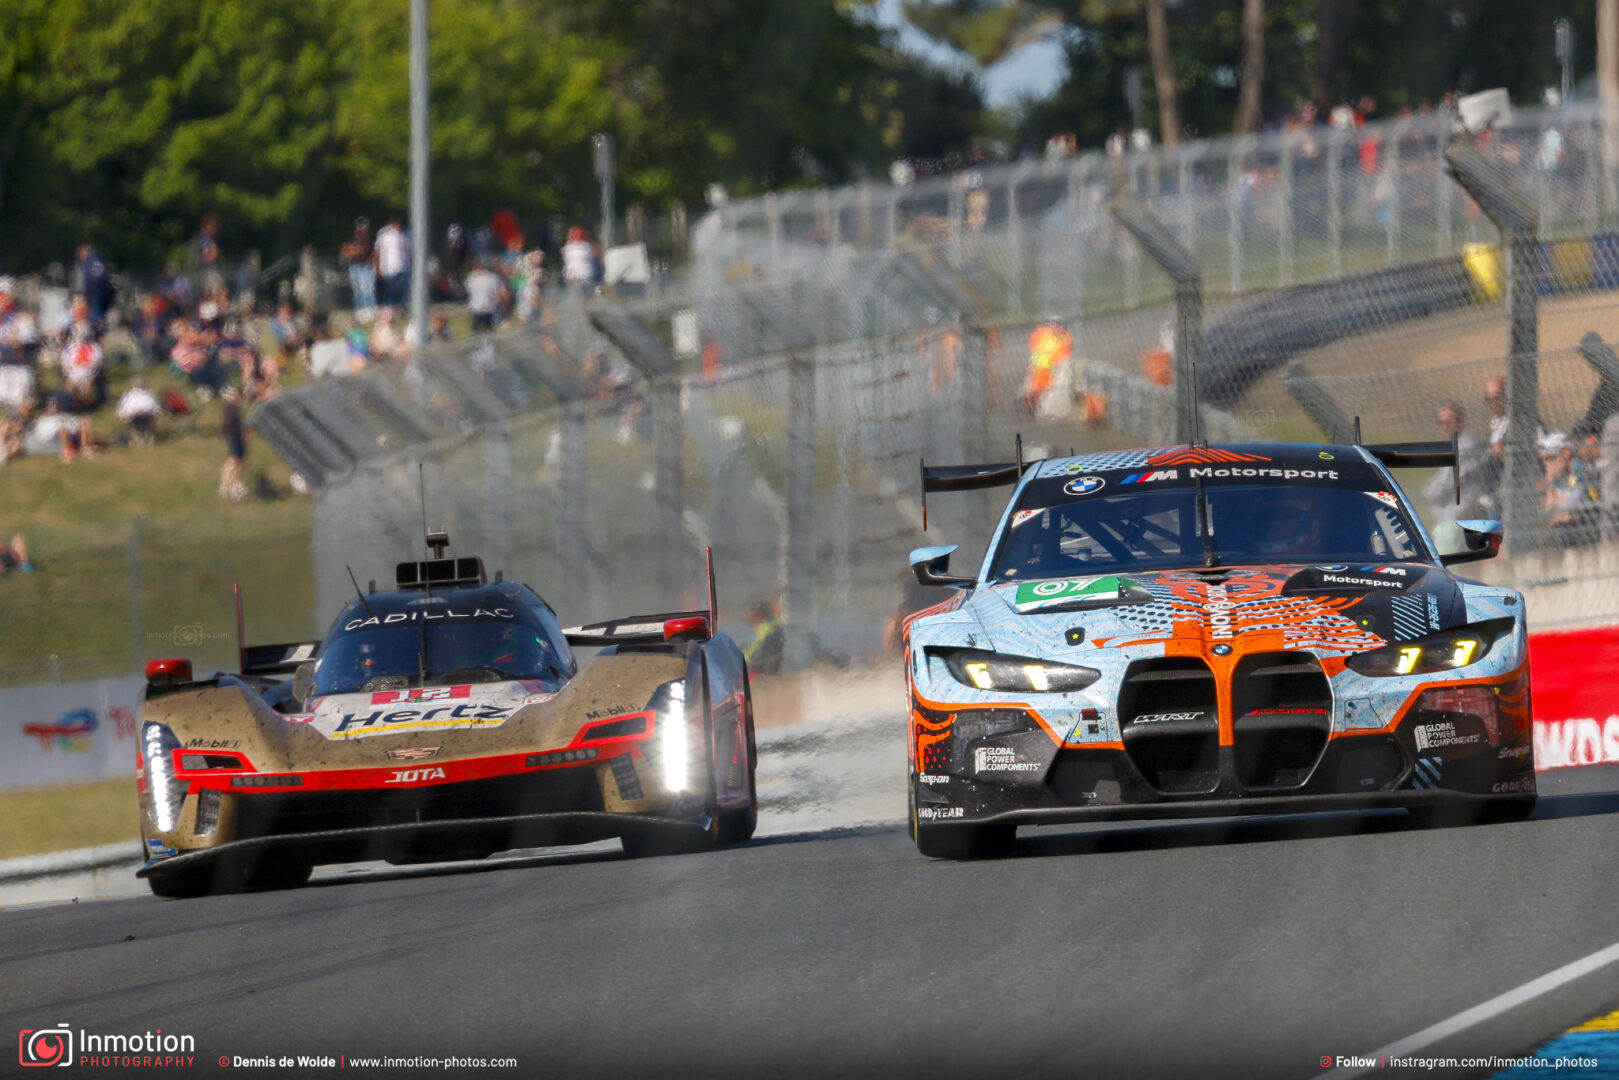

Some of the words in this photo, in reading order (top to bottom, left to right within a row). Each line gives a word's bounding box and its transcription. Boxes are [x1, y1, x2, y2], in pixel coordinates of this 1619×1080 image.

[1190, 467, 1338, 480] Motorsport
[1323, 574, 1403, 588] Motorsport
[344, 608, 514, 632] CADILLAC
[335, 704, 514, 731] Hertz
[1426, 722, 1456, 732] GLOBAL
[1428, 730, 1456, 740] POWER
[986, 747, 1016, 756] GLOBAL
[986, 755, 1016, 764] POWER
[384, 767, 446, 784] JOTA
[919, 772, 950, 785] Snap-on
